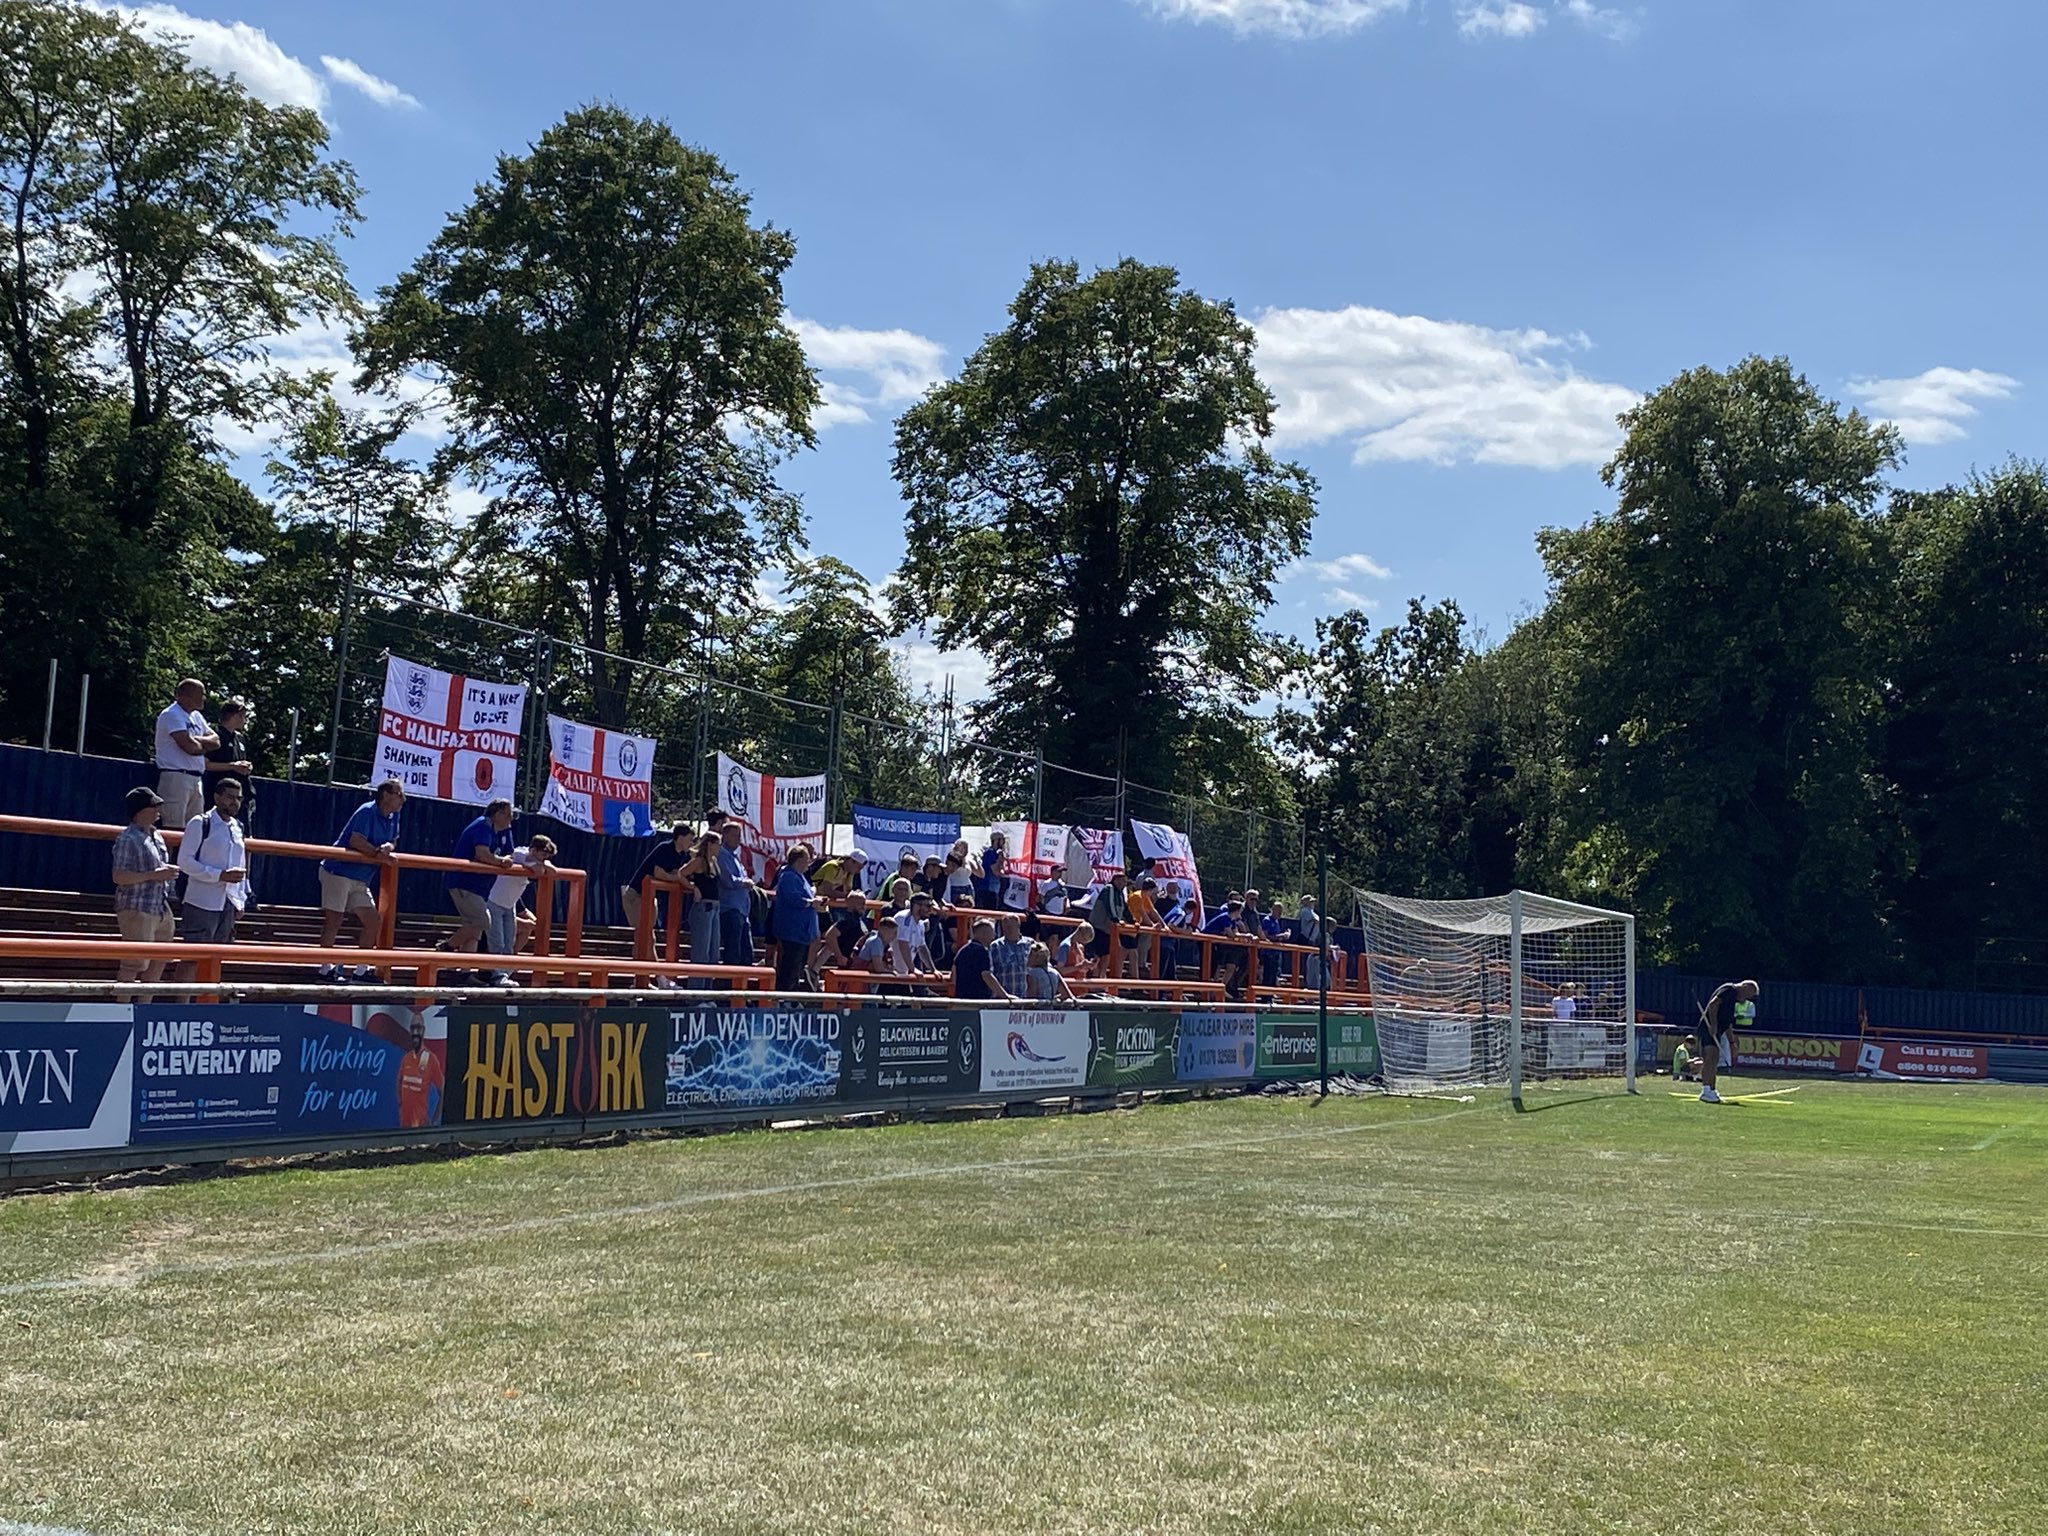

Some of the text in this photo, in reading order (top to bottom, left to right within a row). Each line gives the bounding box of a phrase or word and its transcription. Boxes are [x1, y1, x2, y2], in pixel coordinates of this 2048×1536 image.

[488, 692, 495, 705] A
[383, 713, 516, 755] FC HALIFAX TOWN
[411, 772, 428, 787] DIE
[788, 808, 808, 826] ROAD
[142, 1022, 214, 1047] JAMES
[717, 1013, 802, 1041] WALDEN
[803, 1013, 840, 1040] LTD
[880, 1027, 930, 1042] BLACKWELL
[931, 1027, 937, 1041] &
[1183, 1018, 1254, 1037] ALL-CLEAR SKIP HIRE
[1116, 1028, 1155, 1050] PICKTON
[1261, 1031, 1317, 1060] enterprise
[1737, 1036, 1842, 1058] BENSON
[300, 1034, 386, 1076] Working
[880, 1046, 920, 1057] DELICATESSEN
[926, 1045, 948, 1056] BAKERY
[1901, 1045, 1974, 1058] Call us FREE
[142, 1049, 281, 1076] CLEVERLY MP
[1737, 1055, 1835, 1070] School of Motoring
[1897, 1062, 1925, 1071] 0800
[1949, 1065, 1977, 1075] 0800
[298, 1081, 377, 1119] for you
[666, 1089, 720, 1105] ELECTRICAL
[783, 1085, 837, 1099] CONTRACTORS
